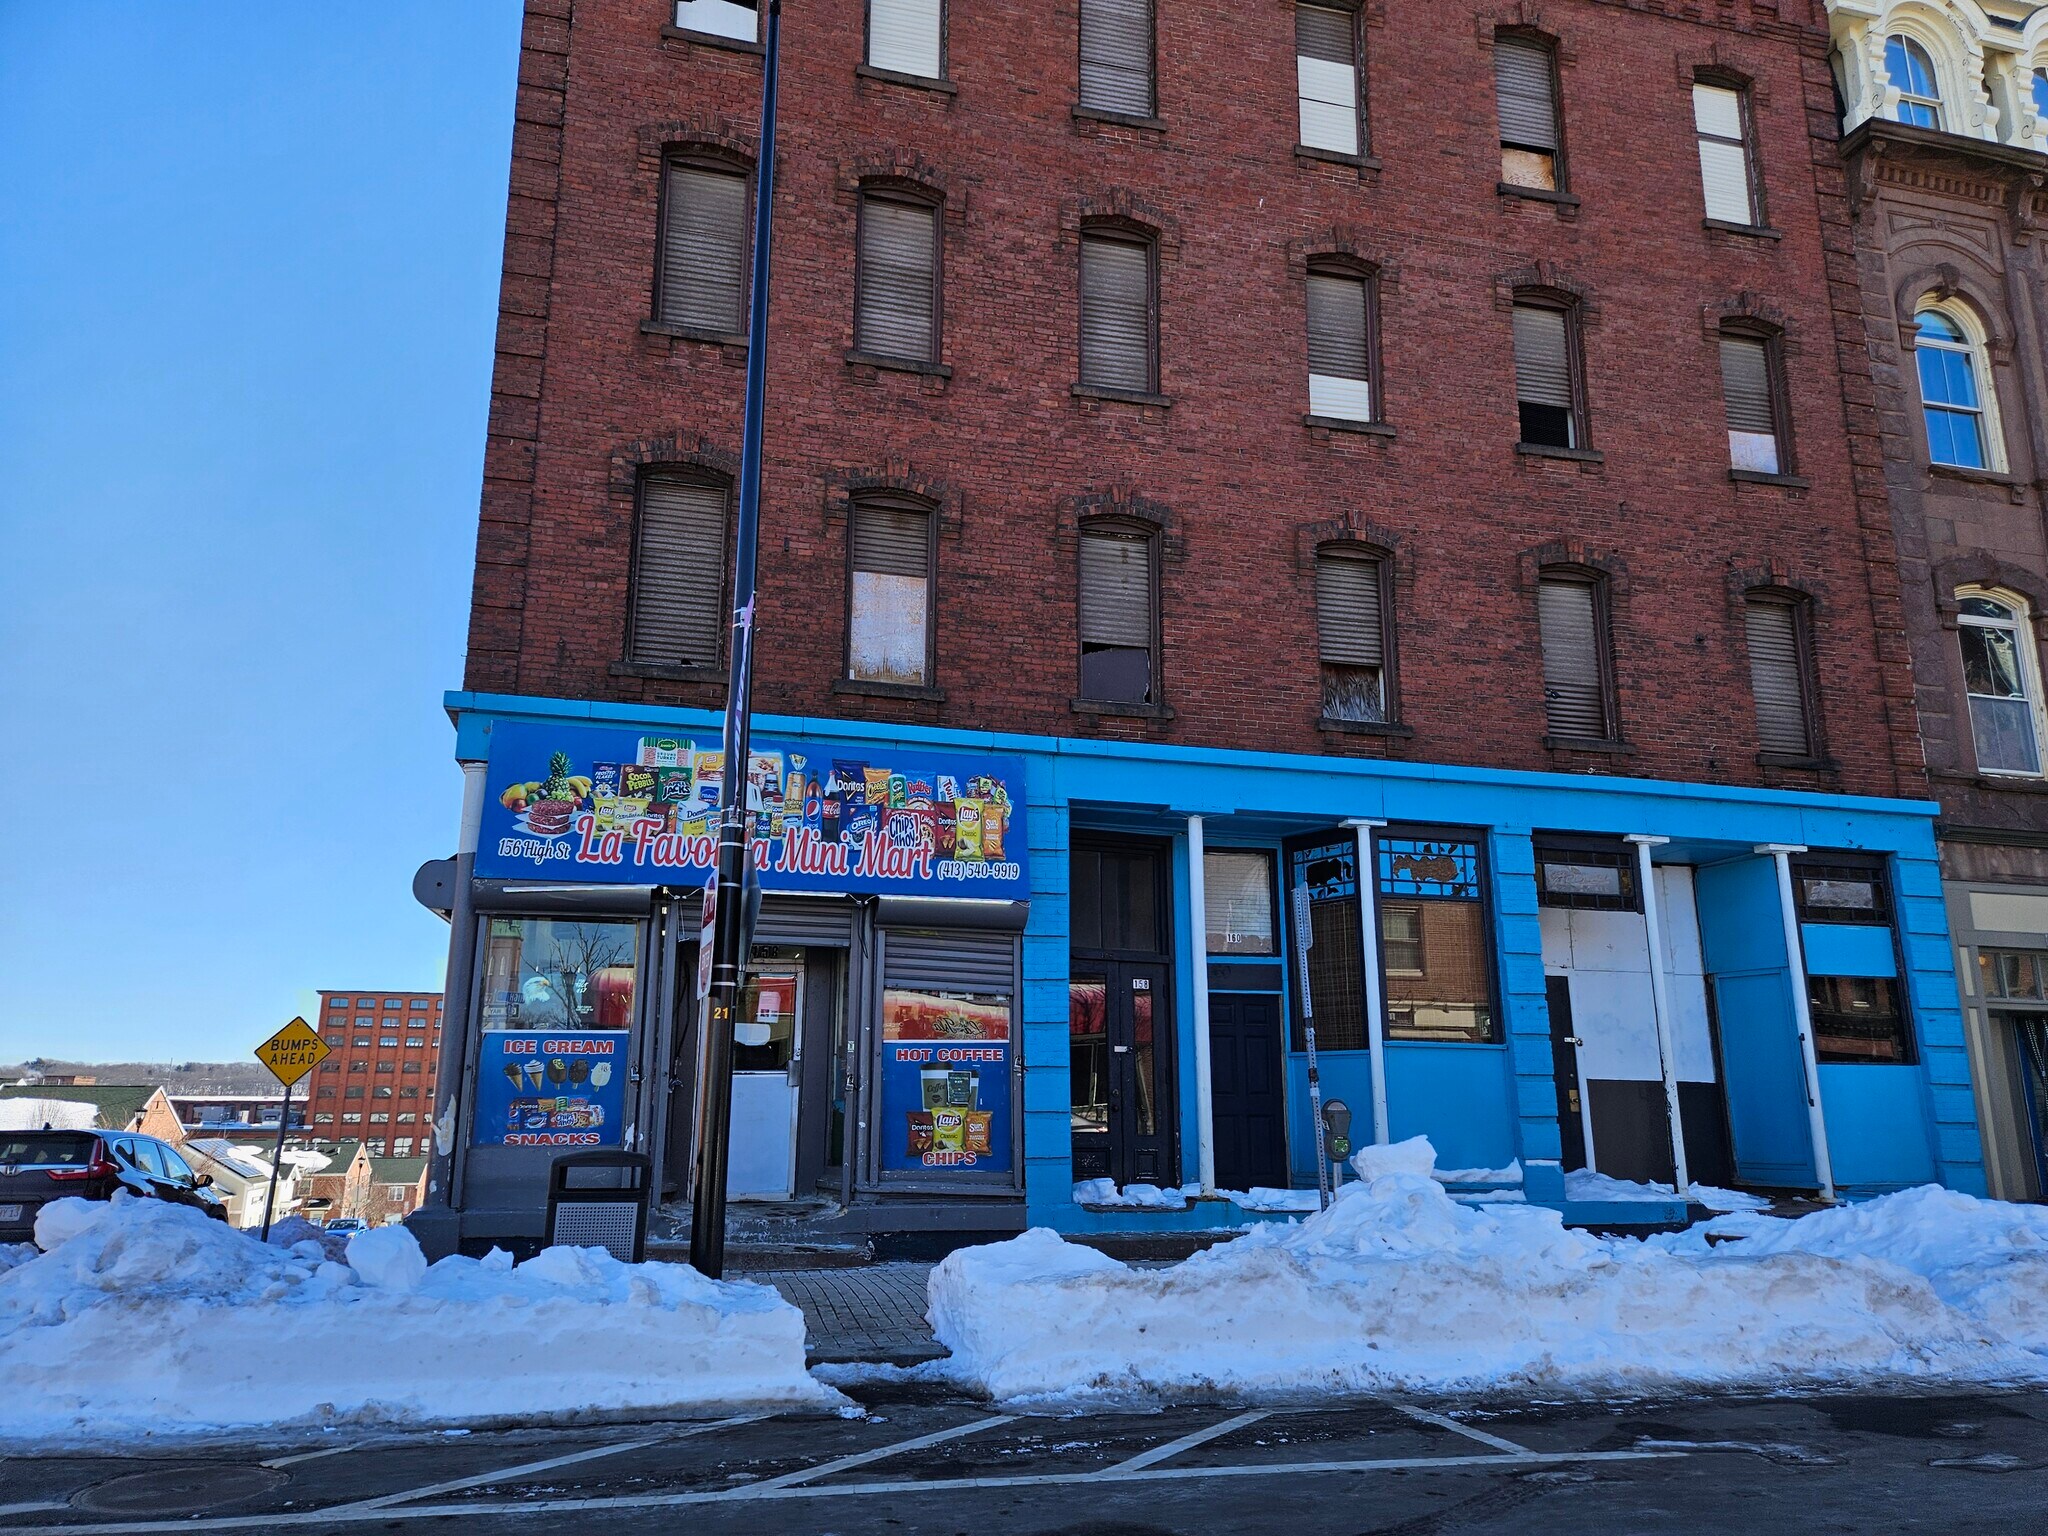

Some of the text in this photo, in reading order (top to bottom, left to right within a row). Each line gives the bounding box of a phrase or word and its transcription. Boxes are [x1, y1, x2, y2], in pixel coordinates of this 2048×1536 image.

[627, 772, 652, 781] COCOA
[626, 778, 655, 791] PEBBLES
[663, 783, 691, 798] JACKS
[837, 780, 865, 792] Doritos
[906, 780, 933, 796] Ruffles
[961, 807, 979, 821] Lay's
[851, 819, 872, 830] OREO
[889, 814, 914, 838] Chips
[938, 817, 956, 825] Doritos
[498, 838, 571, 864] 156 High St
[575, 815, 623, 864] La
[776, 826, 851, 876] Mini
[853, 830, 933, 880] Mart
[937, 861, 1020, 881] (413) 540-9919
[1227, 933, 1241, 943] 160
[713, 1008, 729, 1019] 21
[270, 1038, 319, 1051] BUMPS
[503, 1040, 615, 1054] ICE CREAM
[269, 1052, 316, 1065] AHEAD
[896, 1048, 1004, 1062] HOT COFFEE
[938, 1115, 960, 1127] Lay's
[911, 1124, 934, 1132] Doritos
[503, 1132, 601, 1146] SNACKS
[922, 1151, 978, 1166] CHIPS
